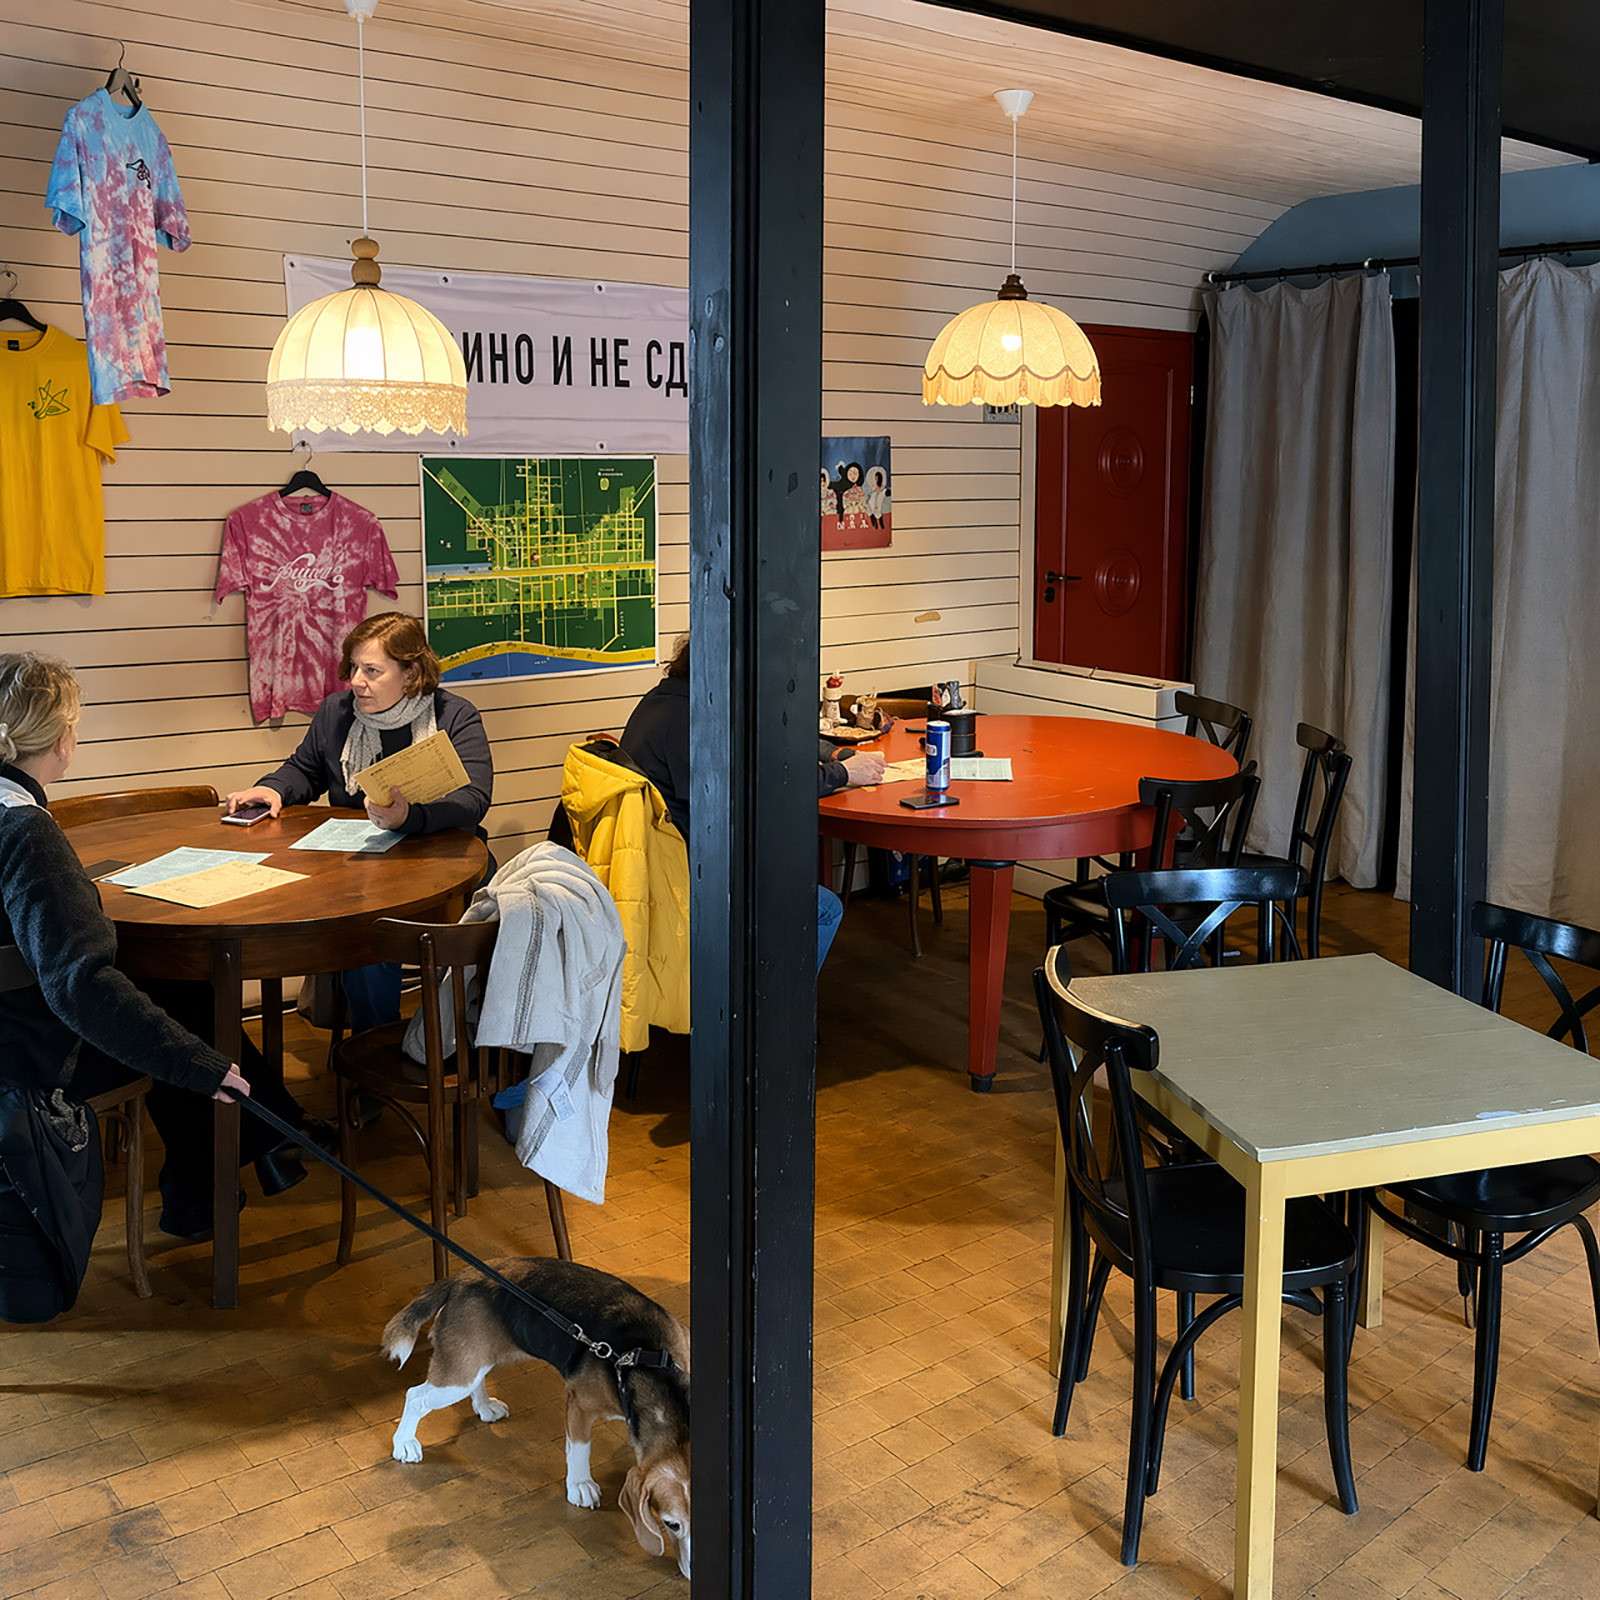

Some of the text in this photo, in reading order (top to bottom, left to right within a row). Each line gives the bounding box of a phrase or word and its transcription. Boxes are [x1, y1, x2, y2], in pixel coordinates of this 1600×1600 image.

[451, 332, 534, 385] ИНО
[552, 335, 573, 386] И
[590, 337, 630, 388] НЕ
